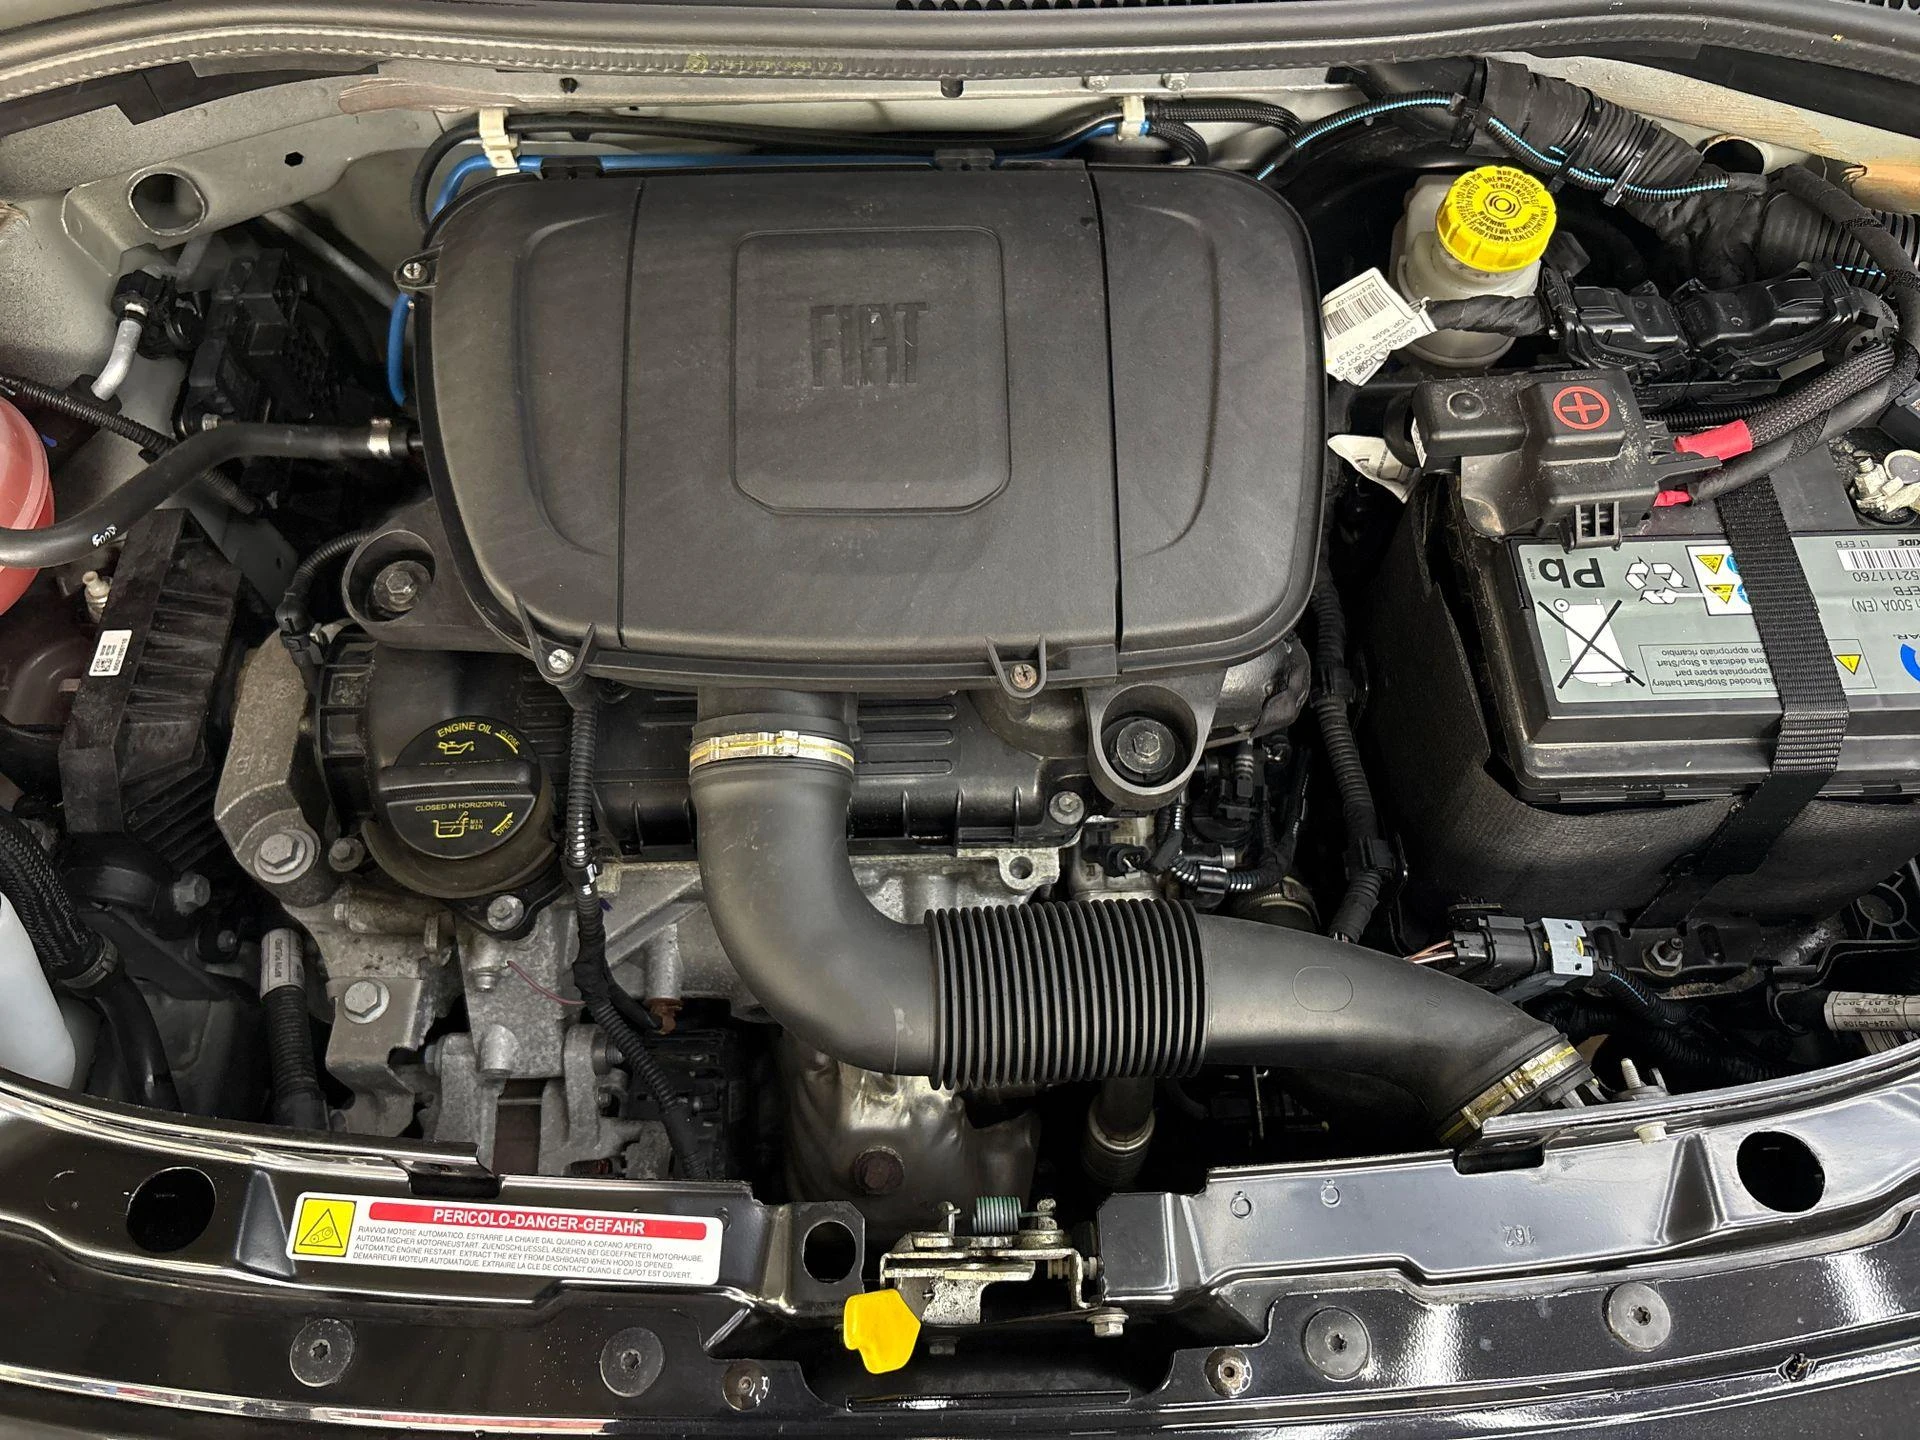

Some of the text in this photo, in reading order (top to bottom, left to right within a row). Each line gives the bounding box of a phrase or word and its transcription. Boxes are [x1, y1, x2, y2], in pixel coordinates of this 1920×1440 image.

[1513, 171, 1542, 194] ORIGINAL
[1468, 220, 1484, 236] FLUID
[1484, 232, 1504, 242] FROM
[1510, 230, 1535, 242] SEALED
[809, 302, 929, 390] FIAT
[1835, 540, 1856, 549] EFB
[1538, 556, 1605, 589] Pb
[1851, 597, 1879, 613] (EN)
[1880, 599, 1914, 612] 500A
[1661, 648, 1698, 656] ricambio
[1700, 647, 1749, 656] appropriato
[1657, 658, 1700, 668] Stop/Start
[1710, 658, 1746, 666] dedicata
[1675, 667, 1768, 677] appropriate spare part
[1652, 679, 1681, 688] battery
[1681, 678, 1728, 688] Stop/Start
[1729, 677, 1762, 686] flooded
[437, 722, 493, 738] ENGINE OIL
[500, 729, 521, 749] CLOSE
[415, 803, 447, 812] CLOSED
[458, 801, 507, 809] HORIZONTAL
[495, 818, 514, 838] OPEN
[433, 1208, 645, 1235] PERICOLO-DANGER-GEFAHR
[356, 1235, 416, 1246] AUTOMATISCHER
[482, 1242, 549, 1253] ZUENDSCHLUESSEL
[551, 1246, 586, 1256] ABZIEHEN
[600, 1249, 651, 1259] GEOEFFNETER
[387, 1227, 417, 1236] MOTORE
[418, 1230, 465, 1240] AUTOMATICO.
[514, 1235, 540, 1244] CHIAVE
[541, 1237, 554, 1245] DAL
[556, 1238, 586, 1247] QUADRO
[593, 1240, 623, 1249] COFANO
[624, 1243, 652, 1251] APERTO
[354, 1244, 395, 1253] AUTOMATIC
[396, 1246, 422, 1254] ENGINE
[459, 1250, 492, 1259] EXTRACT
[507, 1253, 522, 1261] KEY
[523, 1254, 545, 1262] FROM
[545, 1255, 589, 1264] DASHBOARD
[590, 1258, 611, 1266] WHEN
[352, 1252, 398, 1262] DEMARREUR
[398, 1255, 428, 1264] MOTEUR
[482, 1260, 516, 1269] EXTRAIRE
[542, 1263, 552, 1271] DE
[552, 1264, 586, 1273] CONTACT
[587, 1266, 612, 1275] QUAND
[623, 1269, 647, 1277] CAPOT
[647, 1270, 661, 1278] EST
